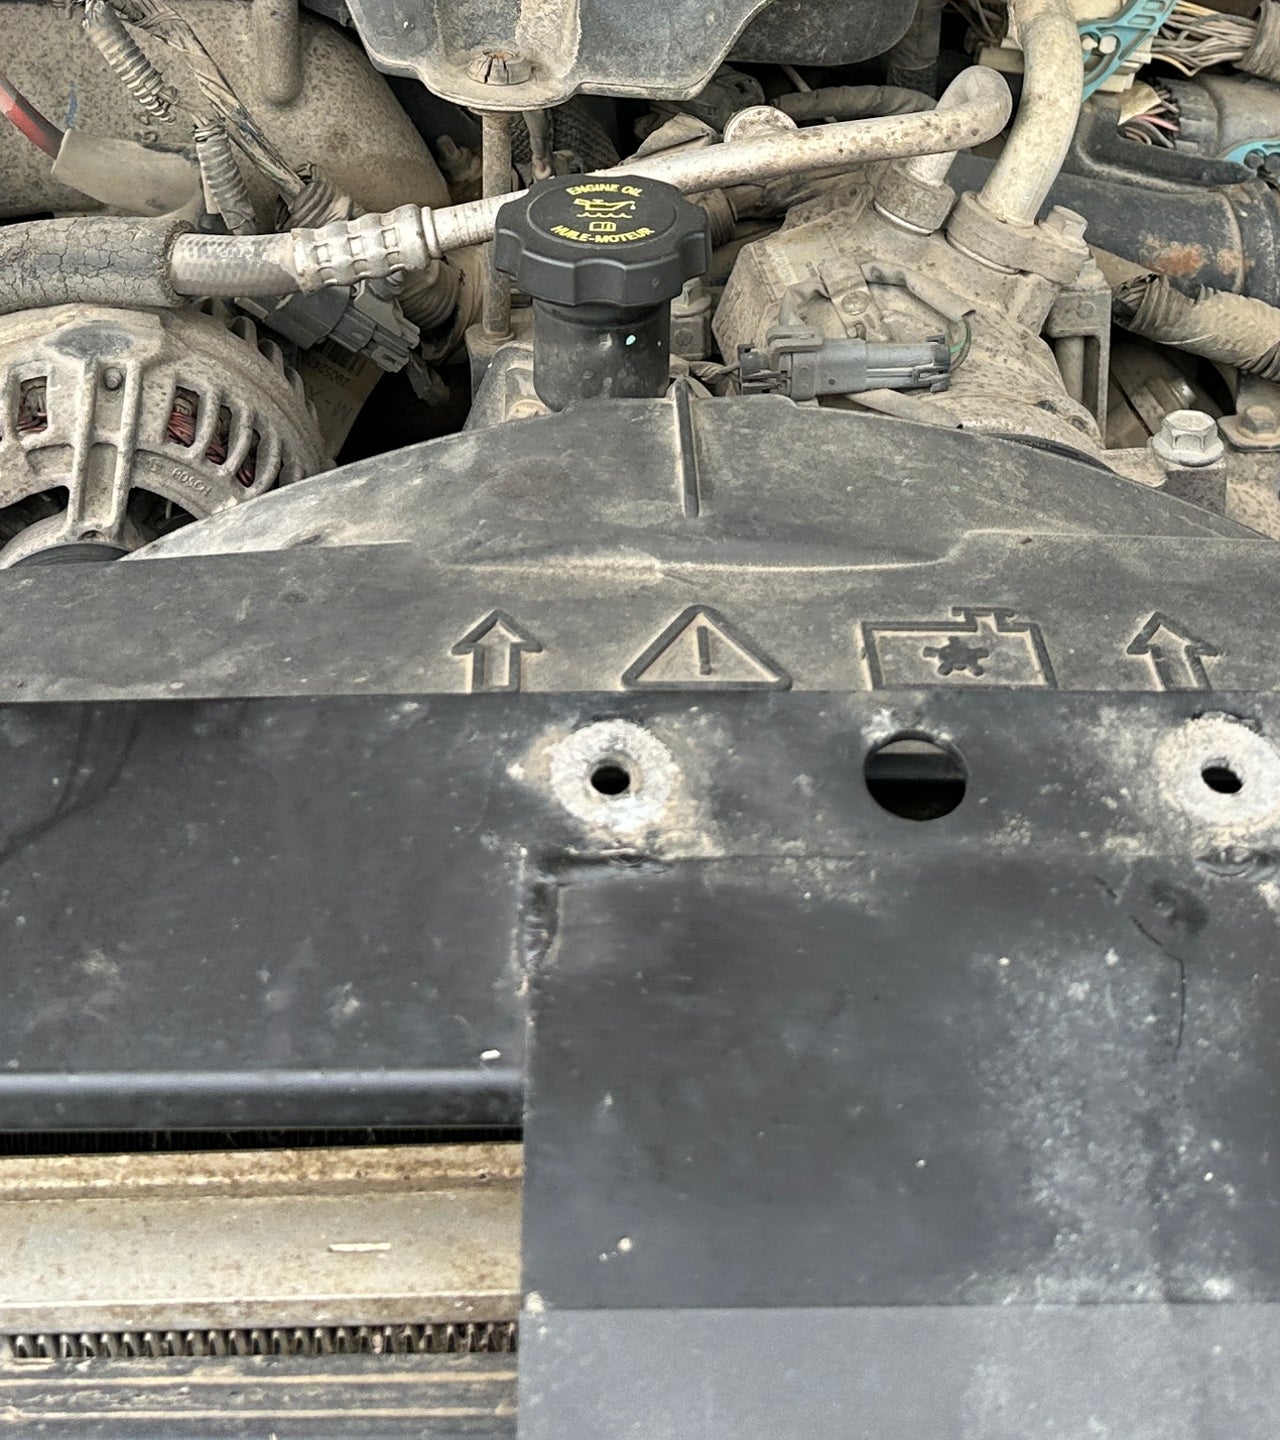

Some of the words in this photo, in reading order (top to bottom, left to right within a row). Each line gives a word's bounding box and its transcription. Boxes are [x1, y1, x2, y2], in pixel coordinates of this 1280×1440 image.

[565, 183, 620, 196] ENGINE
[621, 185, 643, 197] OIL
[550, 225, 656, 243] HUILE-MOTEUR
[171, 468, 213, 497] BOSCH
